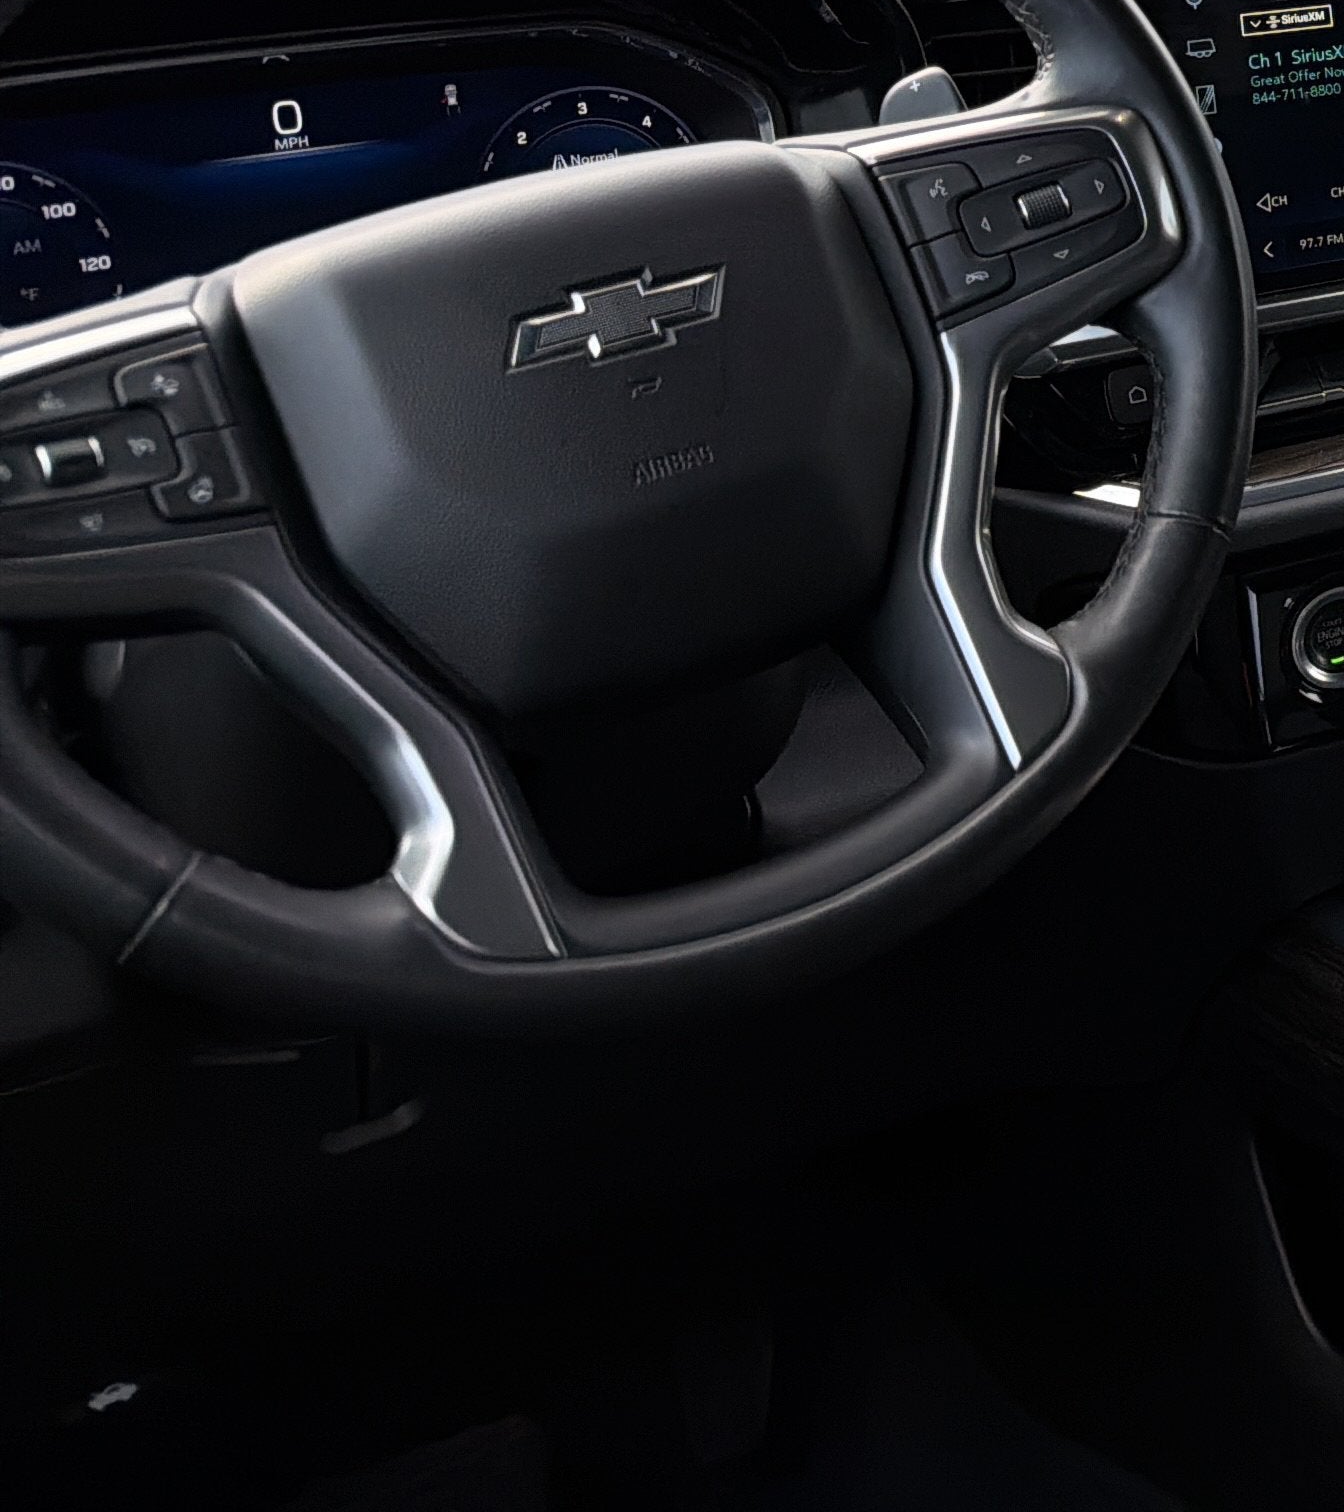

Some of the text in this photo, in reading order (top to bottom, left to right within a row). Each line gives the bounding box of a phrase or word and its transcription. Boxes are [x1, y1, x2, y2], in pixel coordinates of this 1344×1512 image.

[1281, 10, 1326, 26] SiriusXM
[1248, 52, 1271, 70] Ch
[1274, 51, 1283, 66] 1
[1250, 74, 1285, 88] Great
[1288, 68, 1321, 83] Offer
[1252, 82, 1342, 105] 844-711-8800
[577, 101, 588, 115] 3
[272, 100, 303, 135] 0
[641, 115, 652, 128] 4
[274, 134, 310, 151] MPH
[516, 131, 528, 145] 2
[569, 148, 620, 168] Normal
[1271, 194, 1288, 206] CH
[41, 201, 77, 220] 100
[13, 238, 42, 256] AM
[1299, 233, 1344, 250] 97.7 FM
[79, 255, 112, 273] 120
[634, 445, 715, 488] AIRBAG
